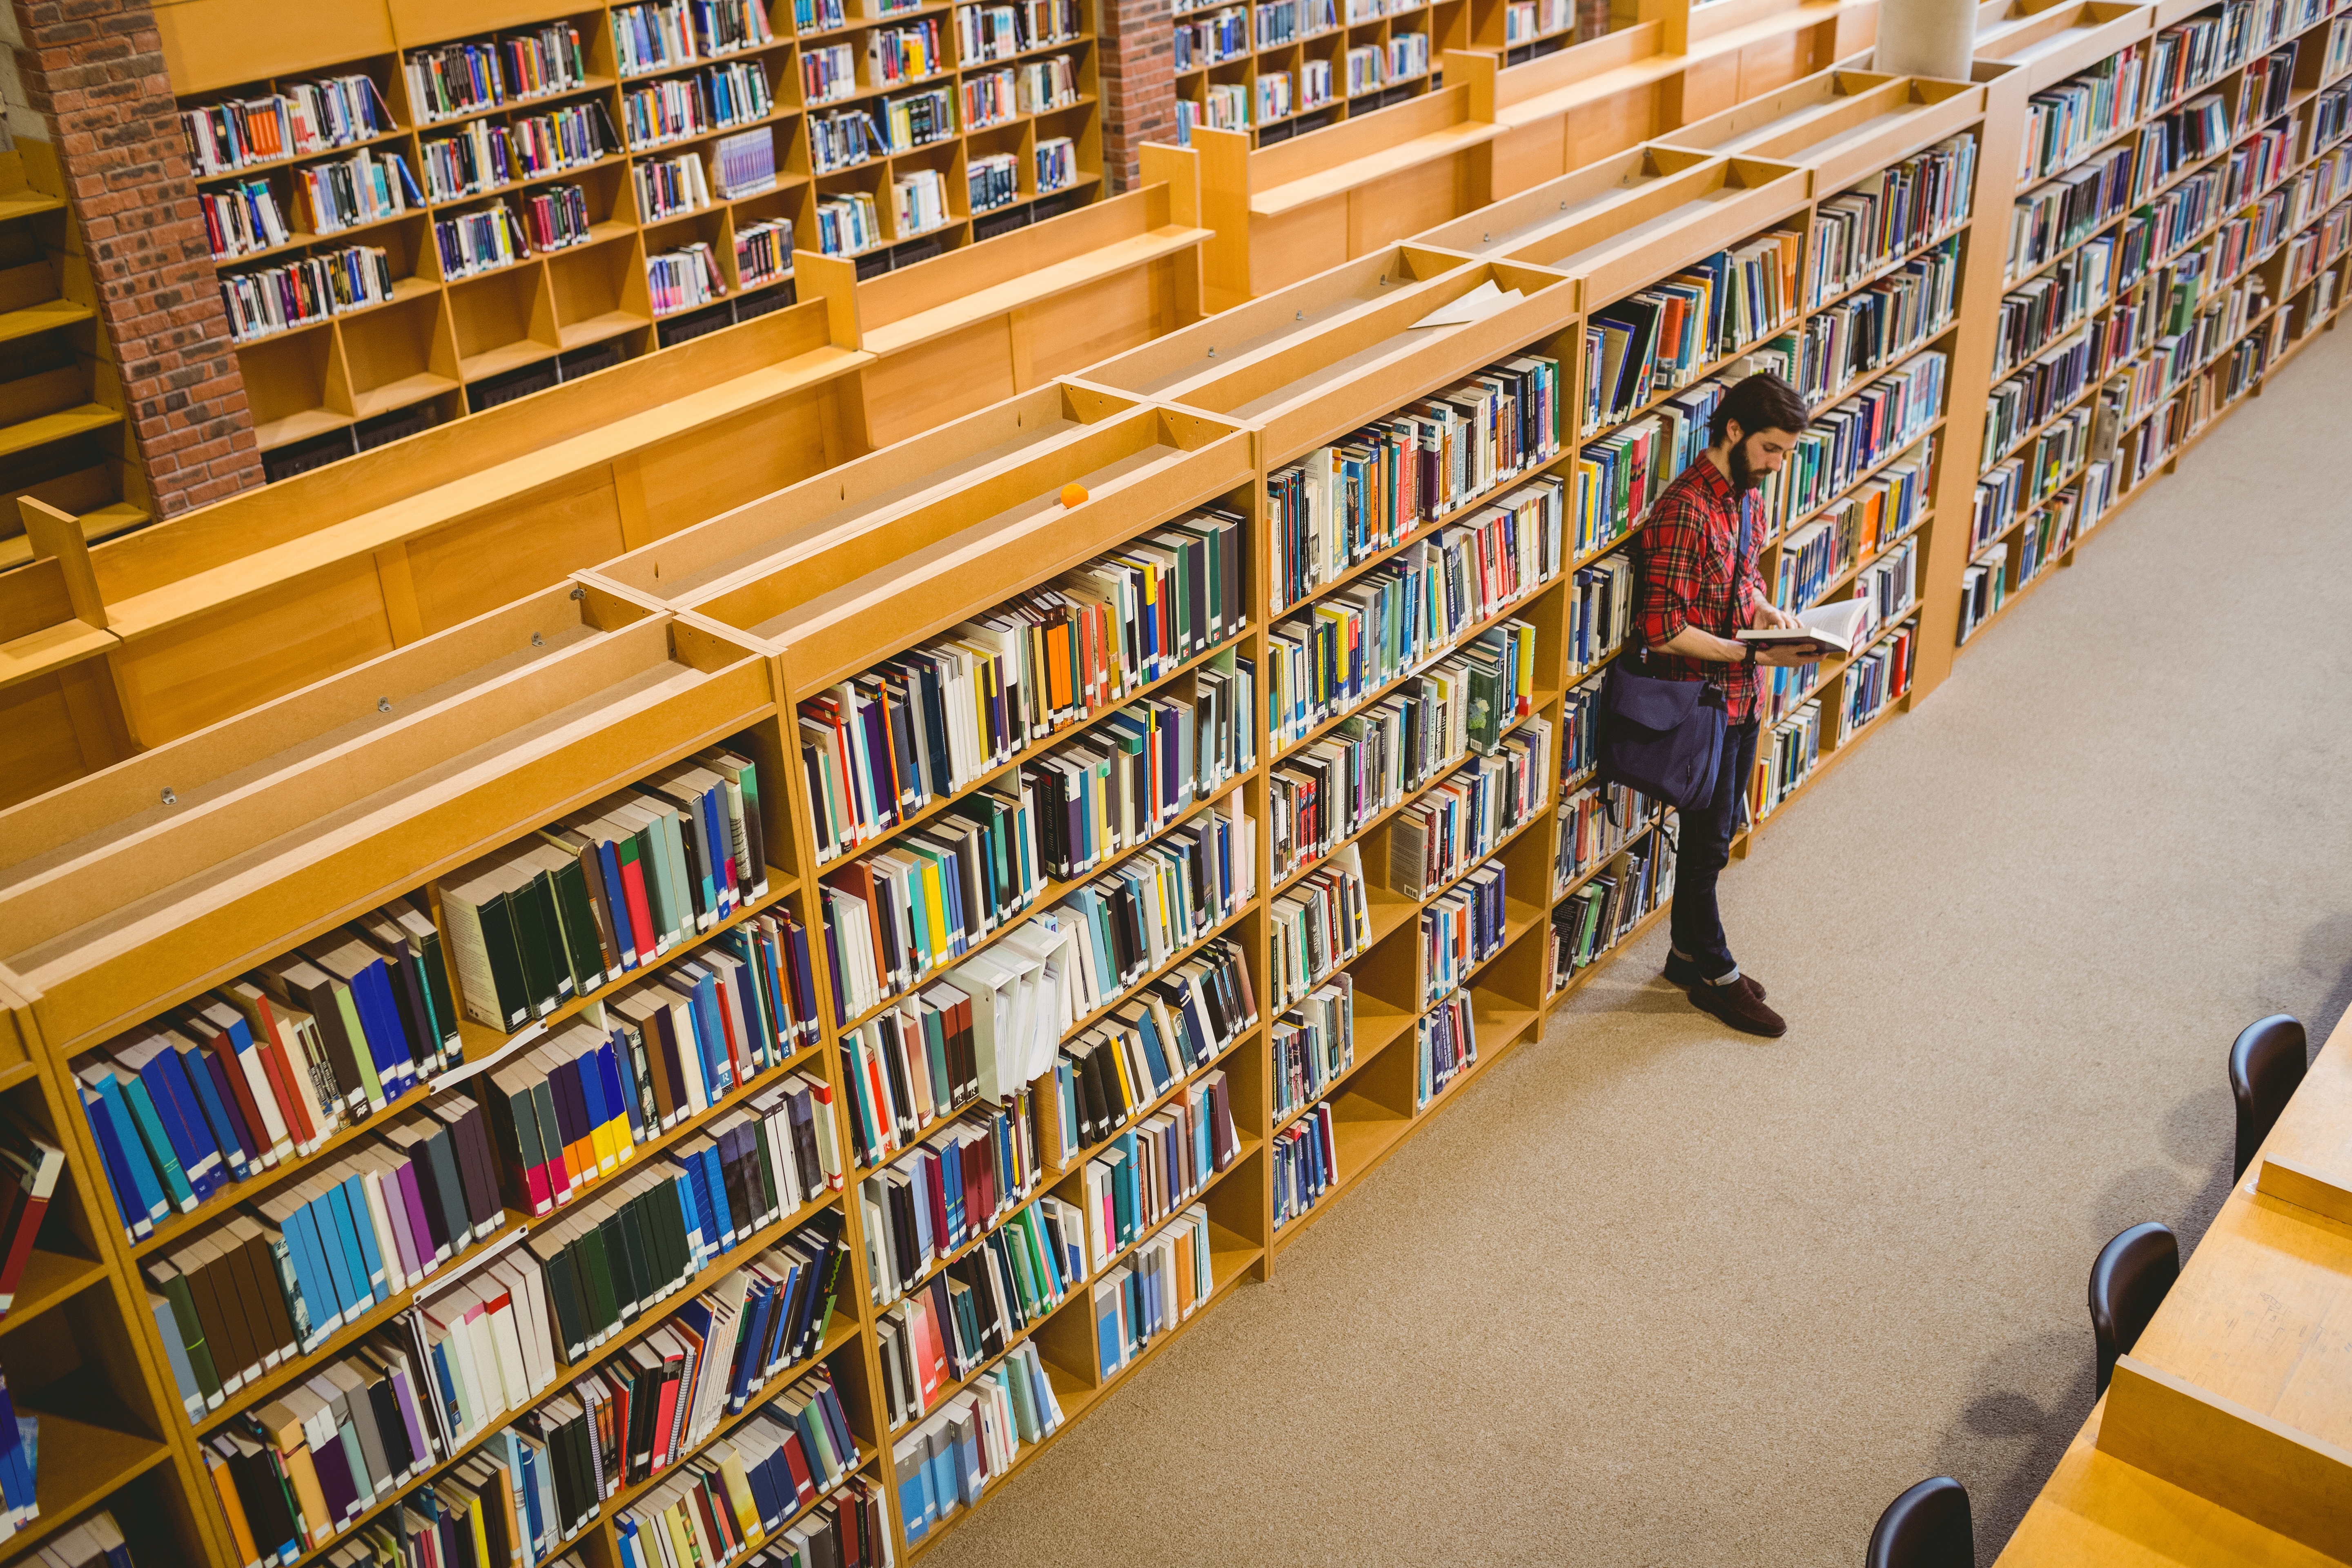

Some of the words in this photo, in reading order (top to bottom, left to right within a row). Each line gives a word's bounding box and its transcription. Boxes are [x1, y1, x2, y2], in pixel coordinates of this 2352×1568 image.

[784, 1046, 789, 1054] R
[327, 1078, 337, 1095] ECONOMICS
[316, 1085, 325, 1101] ECONOMICS
[971, 1087, 976, 1096] R
[958, 1095, 962, 1103] R
[238, 1167, 247, 1176] M
